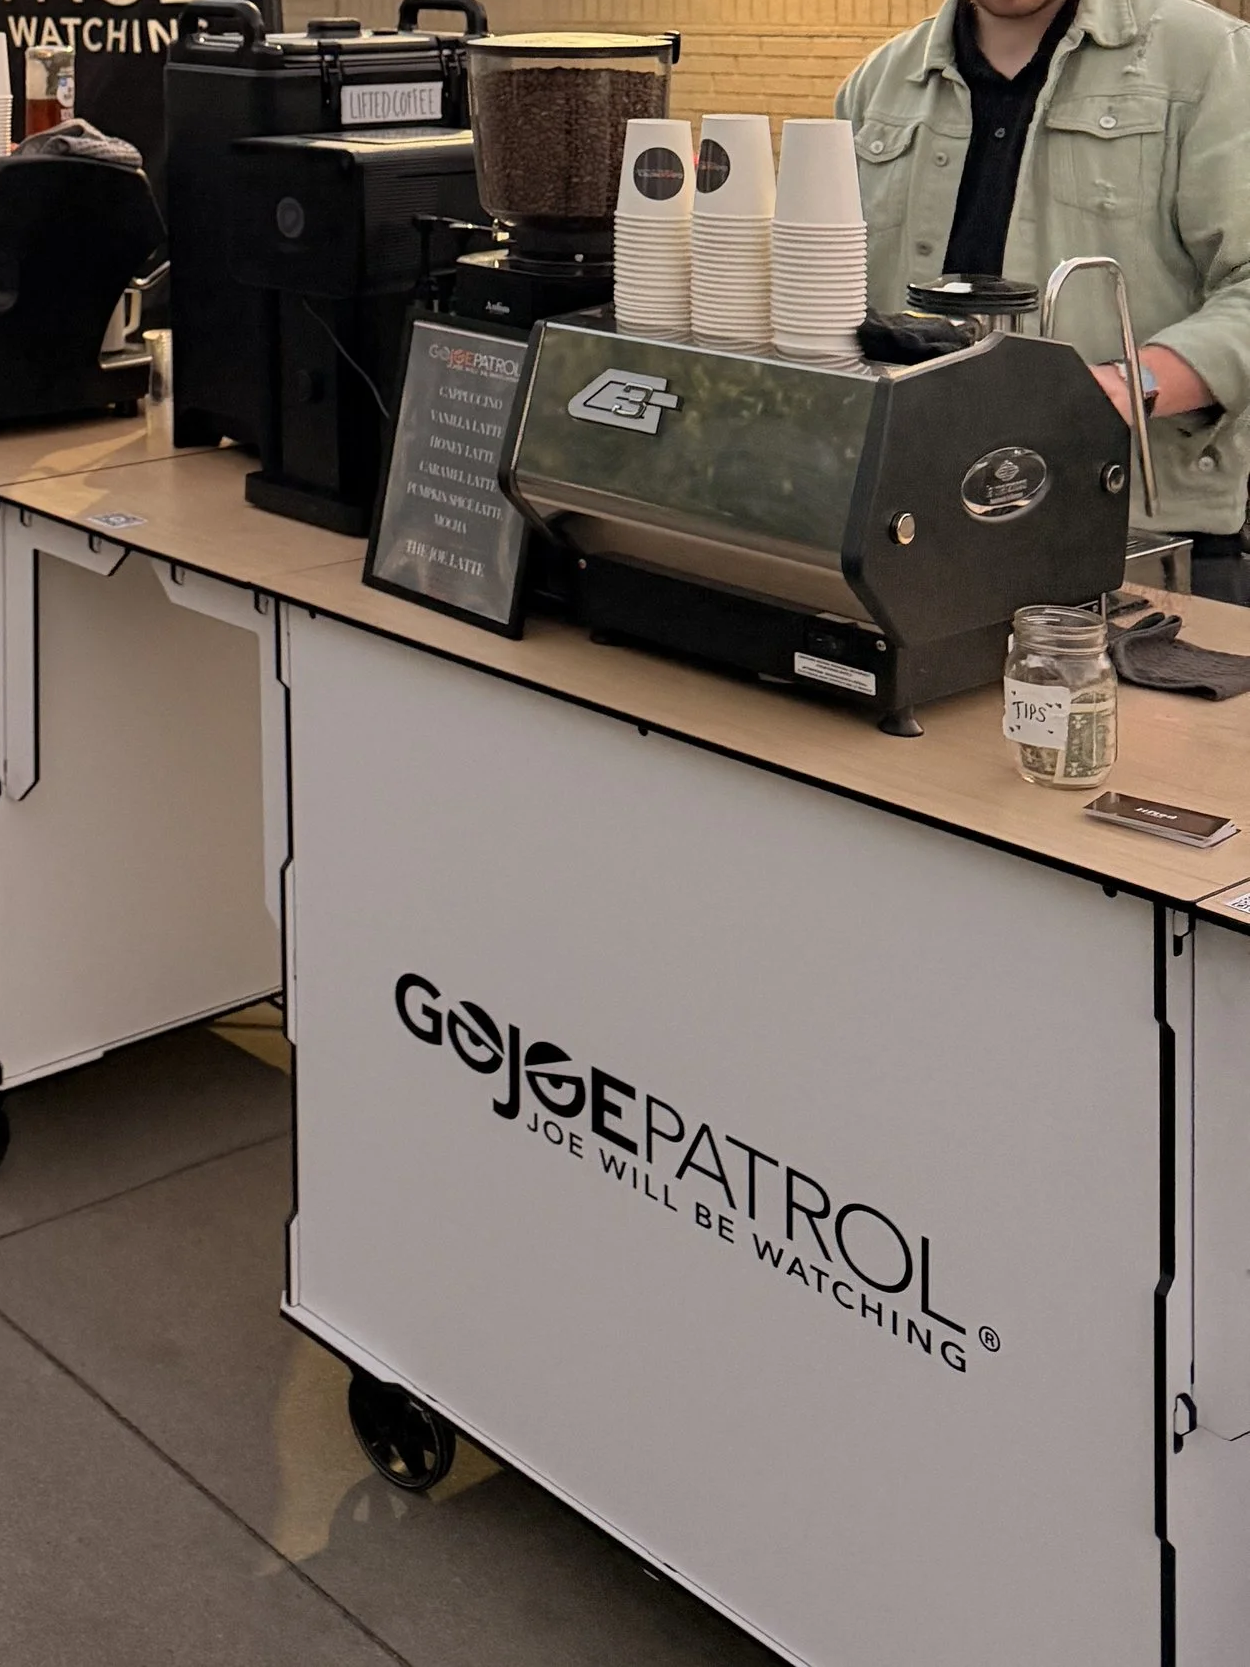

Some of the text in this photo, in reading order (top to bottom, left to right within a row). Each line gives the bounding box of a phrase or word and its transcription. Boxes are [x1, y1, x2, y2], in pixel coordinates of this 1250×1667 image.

[8, 14, 208, 54] WATCHIN
[350, 88, 436, 119] LIFTED COFFEE
[439, 385, 503, 410] CAPPUCCINO
[431, 409, 503, 438] VANILLA LATTE
[429, 435, 496, 464] HONEY LATTE
[419, 460, 498, 493] CARAMEL LATTE
[406, 481, 504, 521] PUMPKIN SPICE LATTE
[434, 513, 468, 535] MOCHA
[406, 539, 427, 557] THE
[449, 554, 485, 577] LATTE
[1012, 700, 1047, 722] TIPS
[527, 1112, 968, 1373] JOE WILL BE WATCHING
